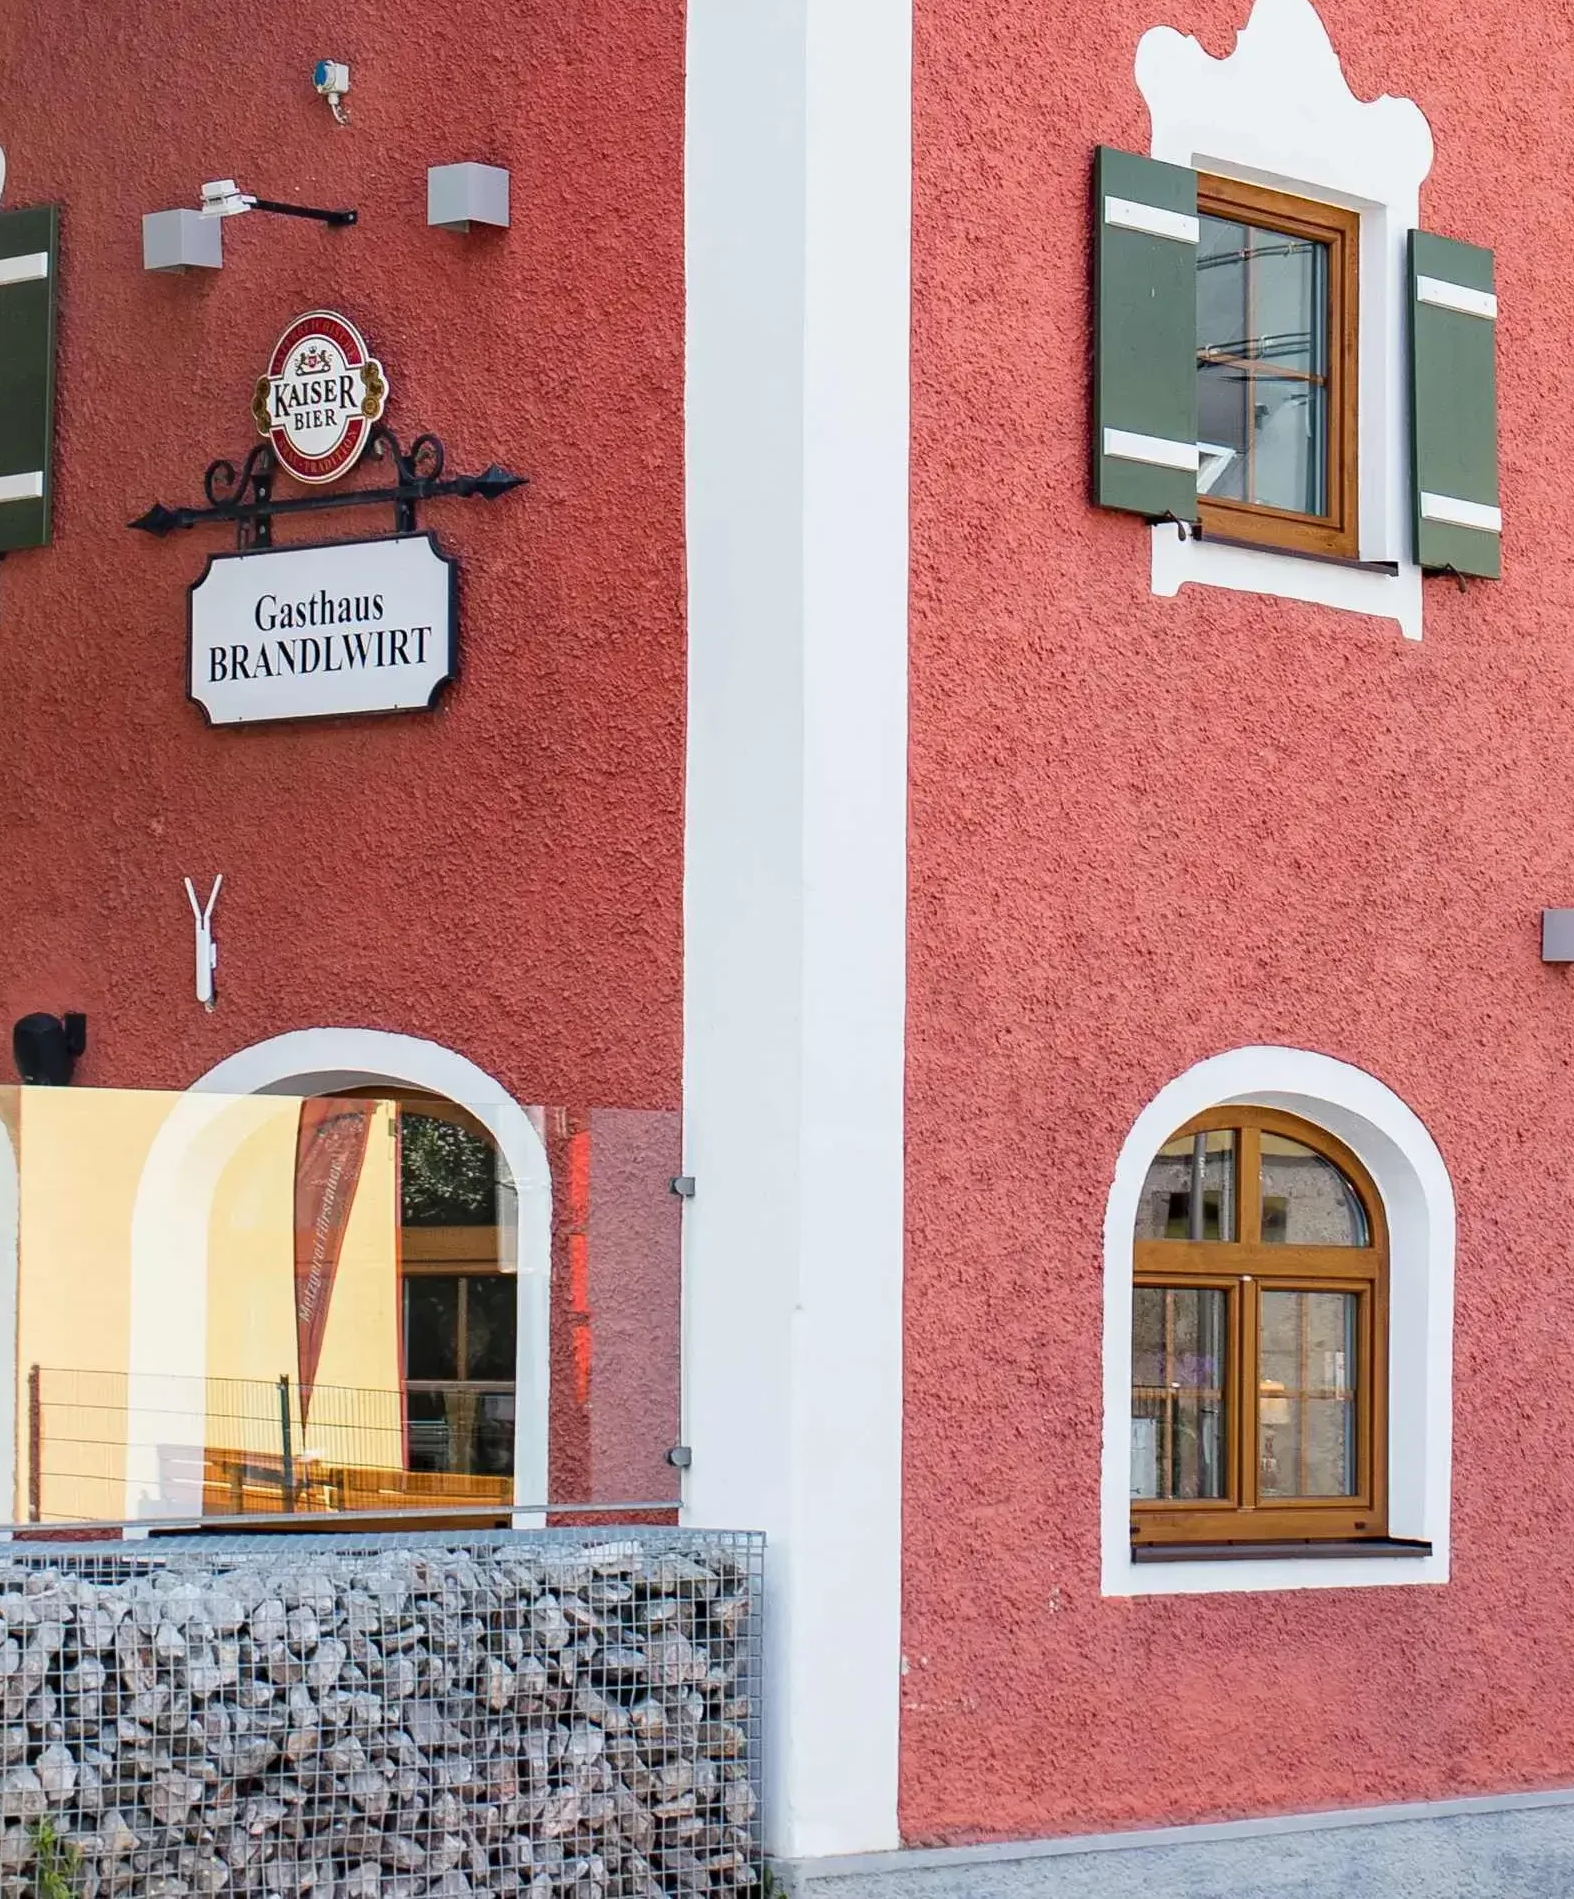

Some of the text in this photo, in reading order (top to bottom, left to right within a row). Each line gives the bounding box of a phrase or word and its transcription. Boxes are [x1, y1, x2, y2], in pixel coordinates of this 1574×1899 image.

[274, 375, 357, 418] KAISER
[294, 408, 337, 431] BIER
[254, 589, 385, 632] Gasthaus
[208, 626, 433, 683] BRANDLWIRT
